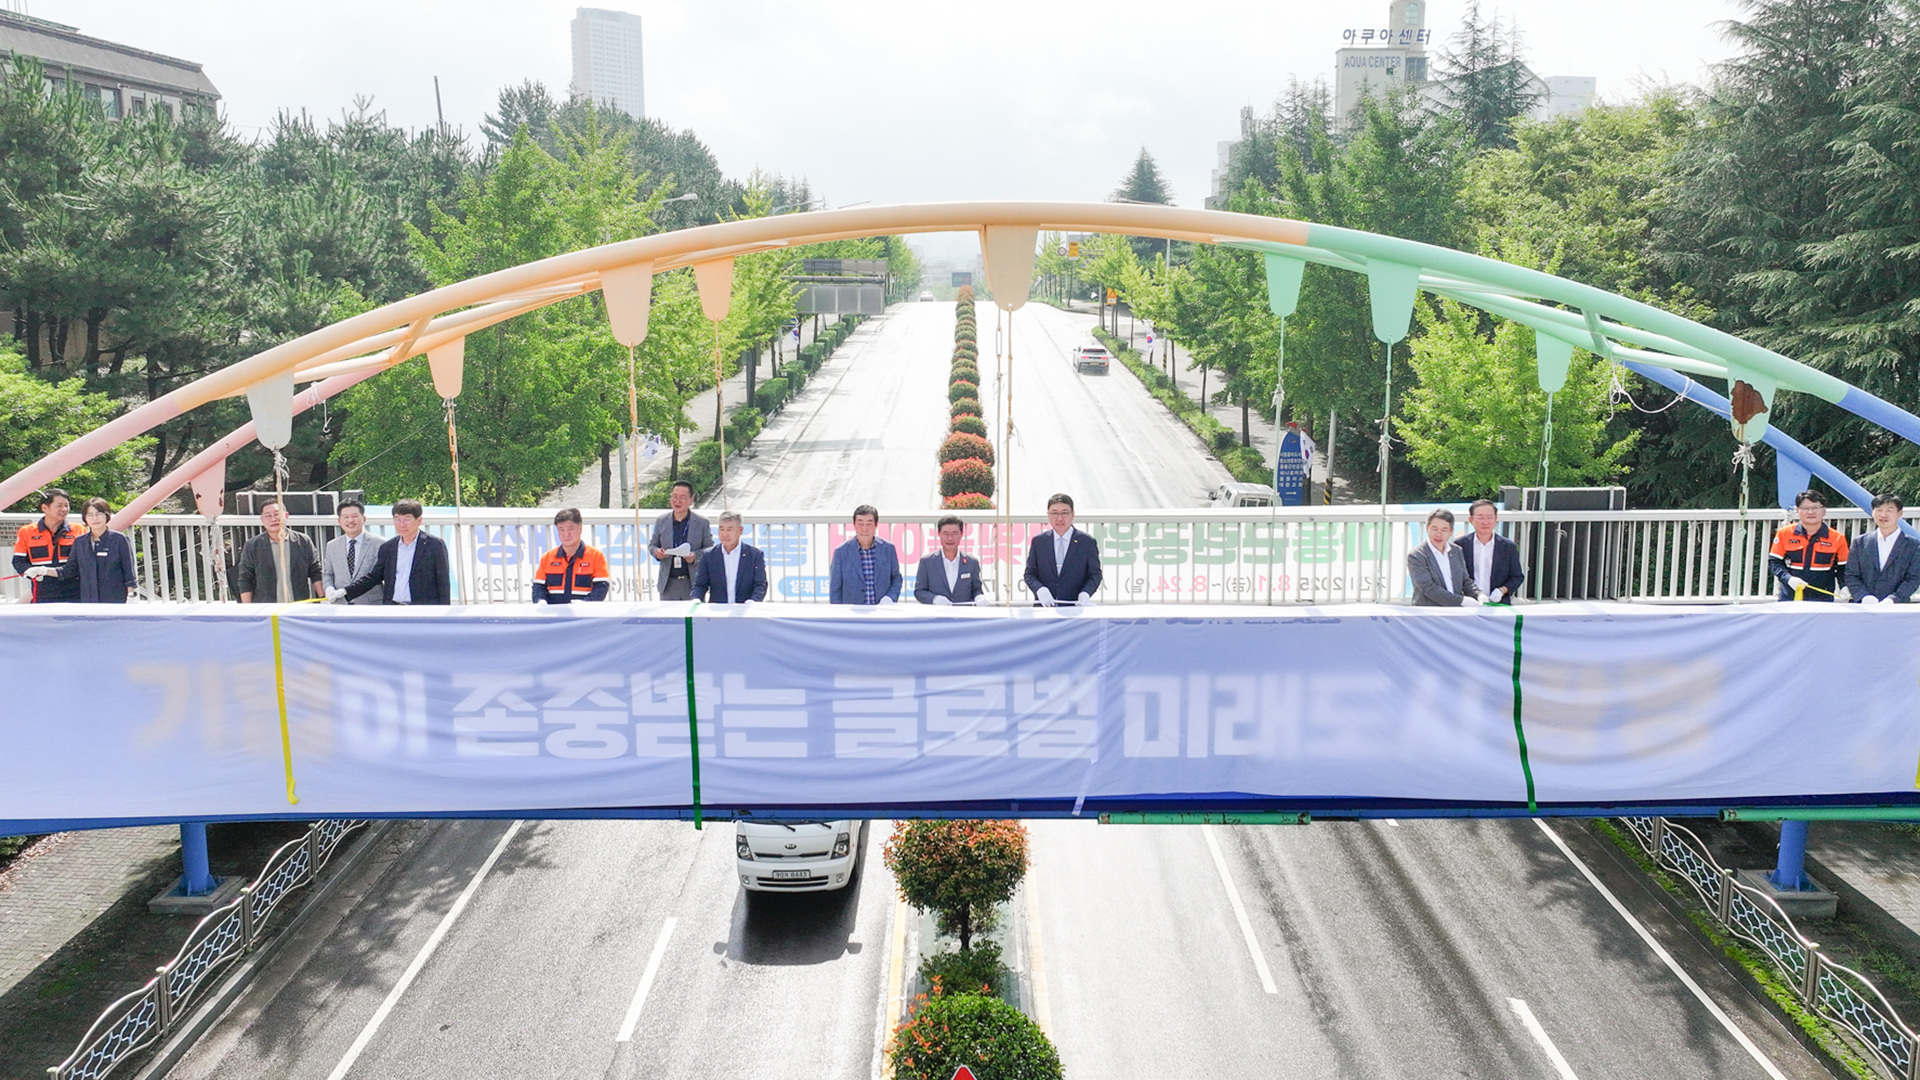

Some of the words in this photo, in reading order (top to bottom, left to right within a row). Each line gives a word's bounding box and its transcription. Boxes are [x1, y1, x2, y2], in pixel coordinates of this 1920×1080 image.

[1343, 29, 1431, 45] 아쿠아센터
[1344, 56, 1366, 68] AQUA
[1368, 56, 1401, 68] CENTER
[452, 671, 809, 759] 존중받는
[834, 673, 1099, 759] 글로벌
